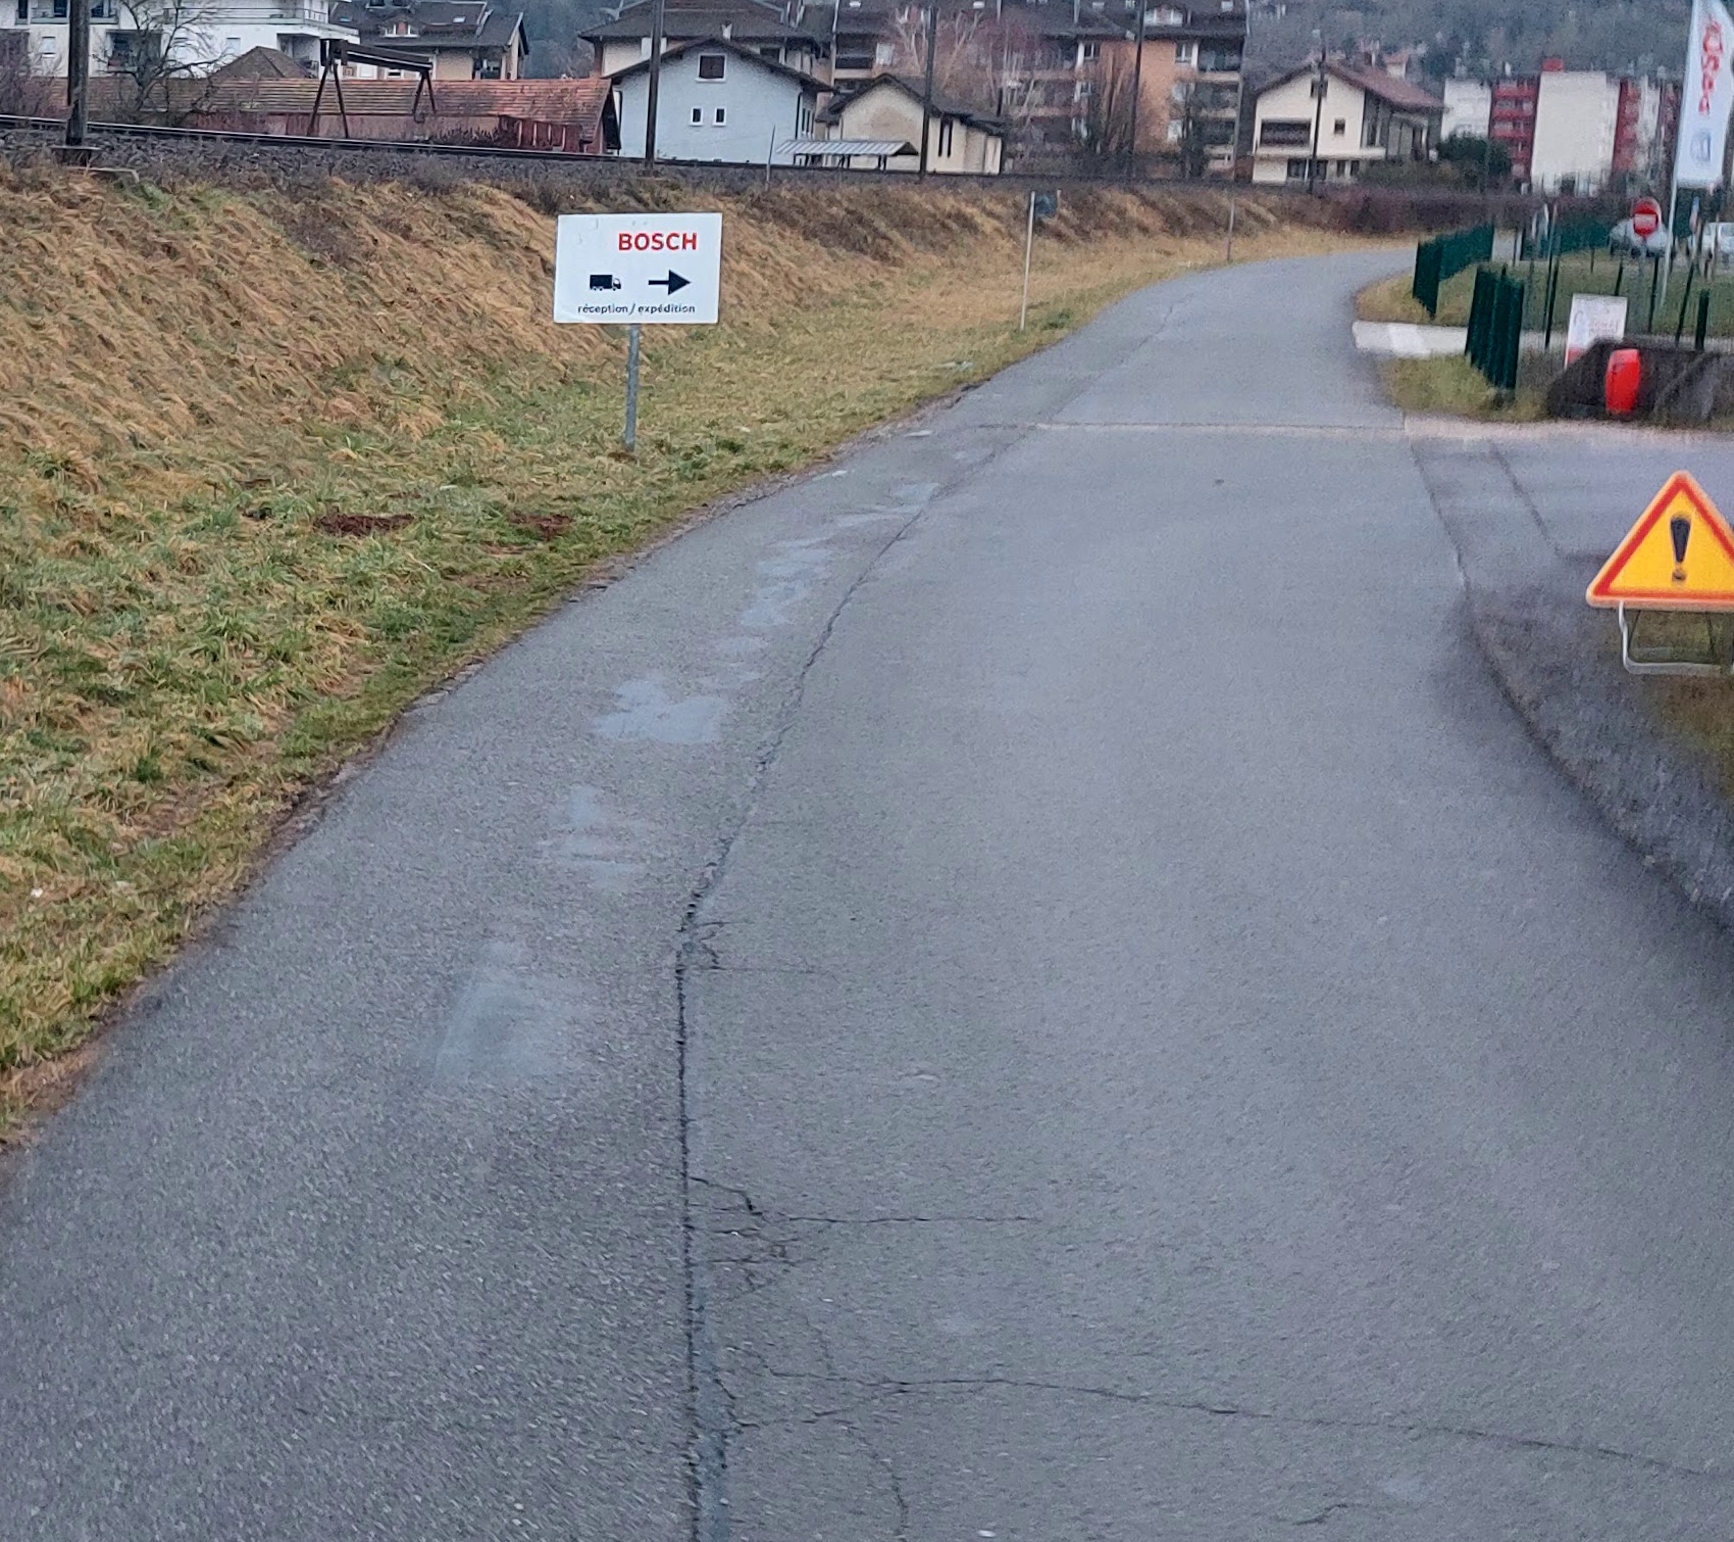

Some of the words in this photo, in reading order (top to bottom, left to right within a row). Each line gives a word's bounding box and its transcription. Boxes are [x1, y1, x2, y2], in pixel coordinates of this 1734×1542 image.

[618, 233, 697, 250] BOSCH
[578, 303, 628, 315] réception
[638, 303, 695, 315] expédition
